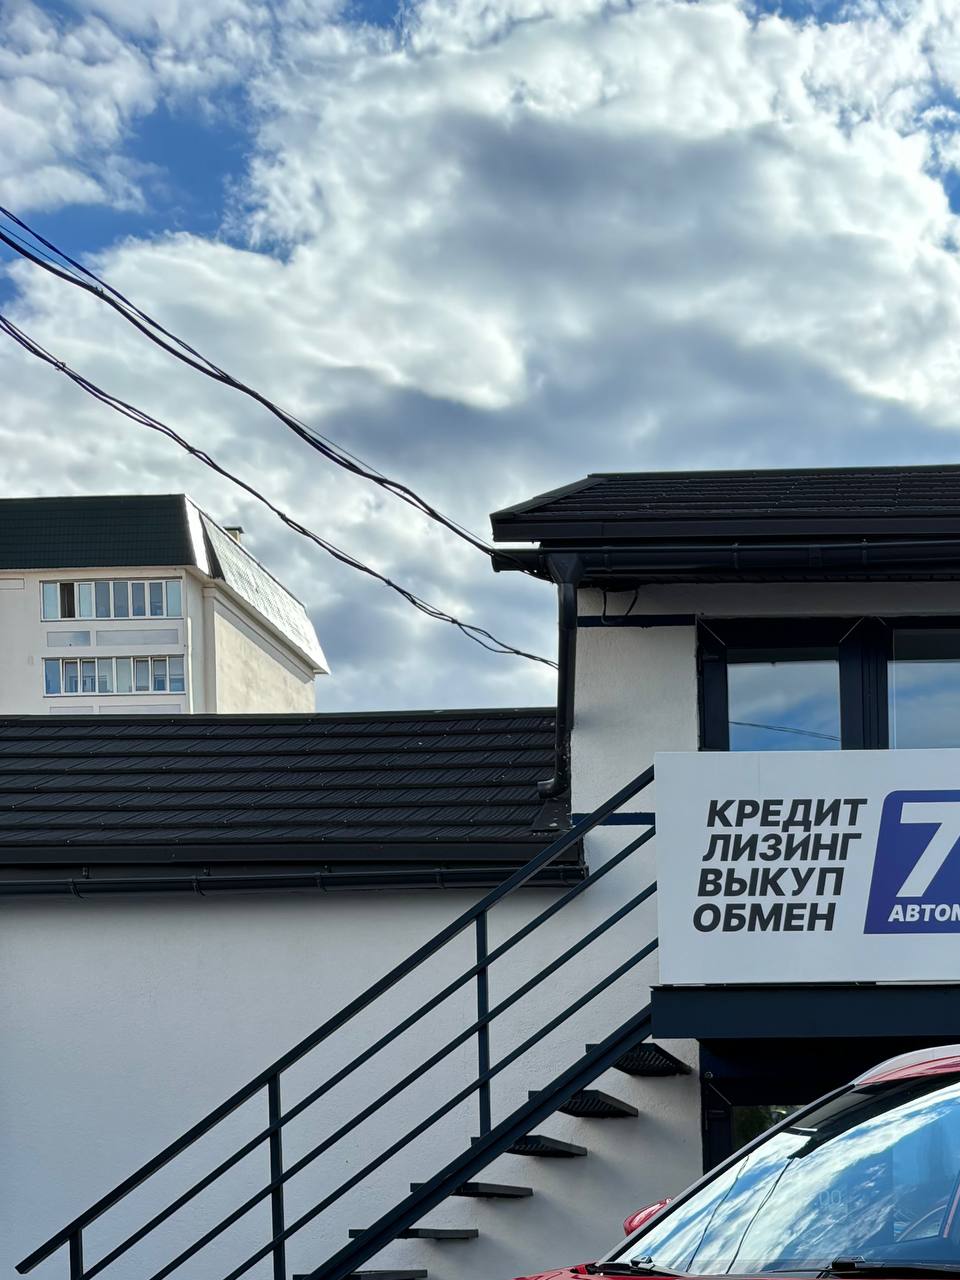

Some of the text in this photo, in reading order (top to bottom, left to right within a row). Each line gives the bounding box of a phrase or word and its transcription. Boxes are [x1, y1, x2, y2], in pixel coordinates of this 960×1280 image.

[706, 798, 869, 833] КРЕДИТ
[701, 832, 863, 862] ЛИЗИНГ
[697, 866, 845, 897] ВЫКУП
[692, 902, 837, 933] ОБМЕН
